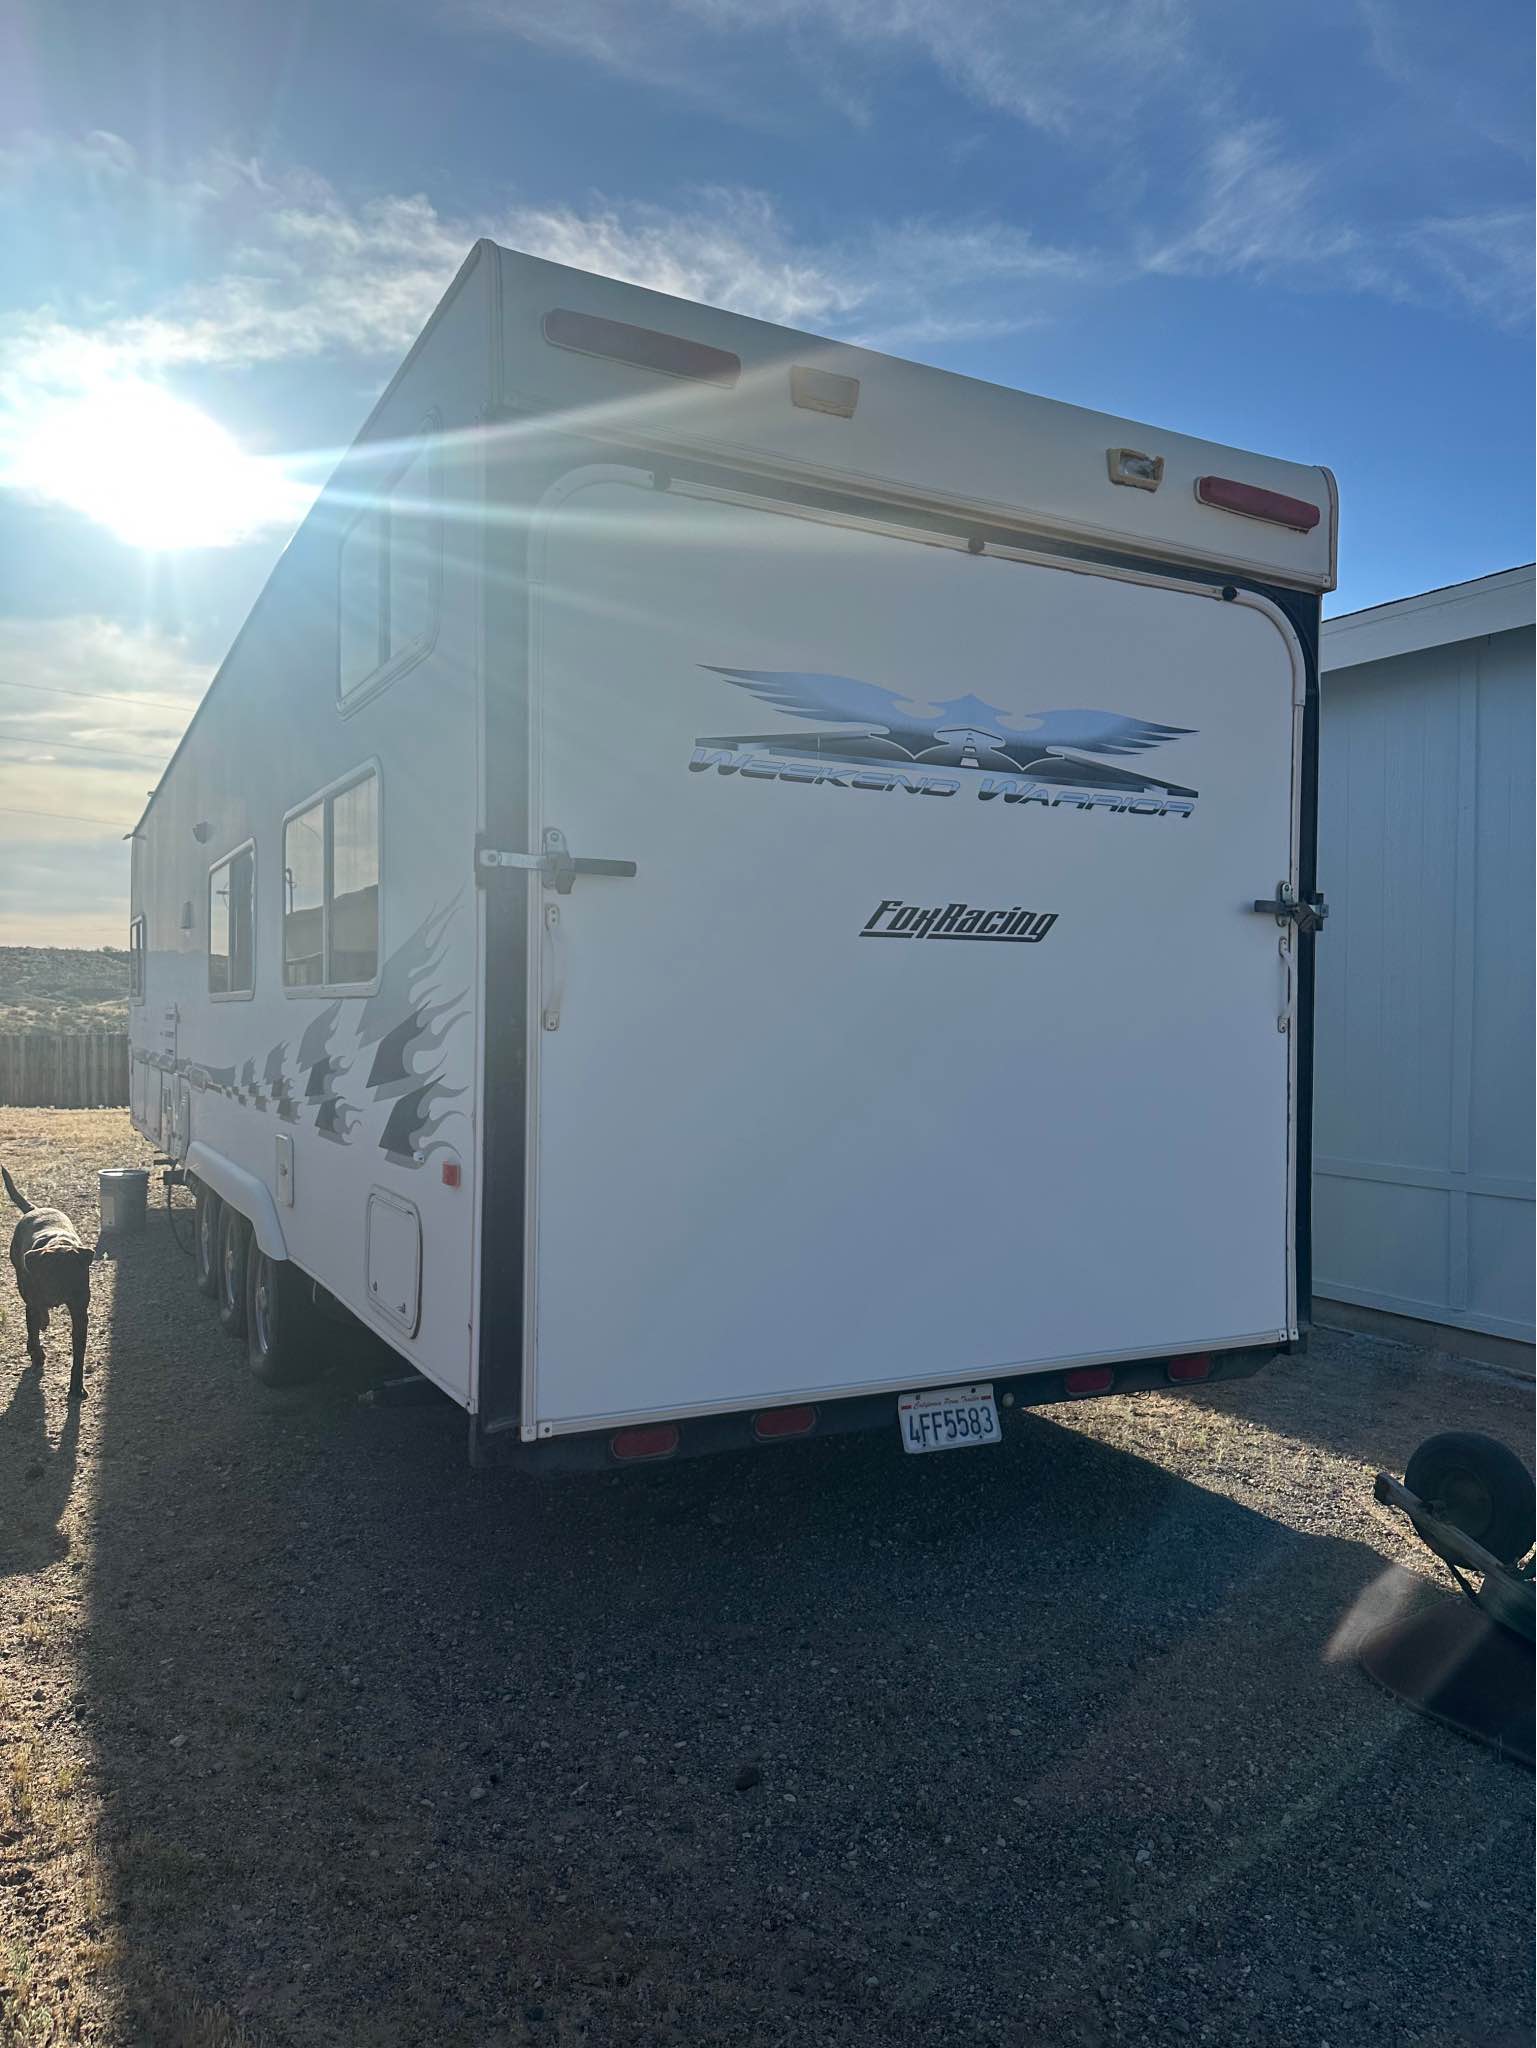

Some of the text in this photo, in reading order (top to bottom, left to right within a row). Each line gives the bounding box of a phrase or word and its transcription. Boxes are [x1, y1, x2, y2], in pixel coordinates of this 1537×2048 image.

[688, 749, 1195, 818] WEEKEND WARRIOR
[858, 900, 1060, 943] FoxRacing
[909, 1406, 994, 1444] 4FF5583
